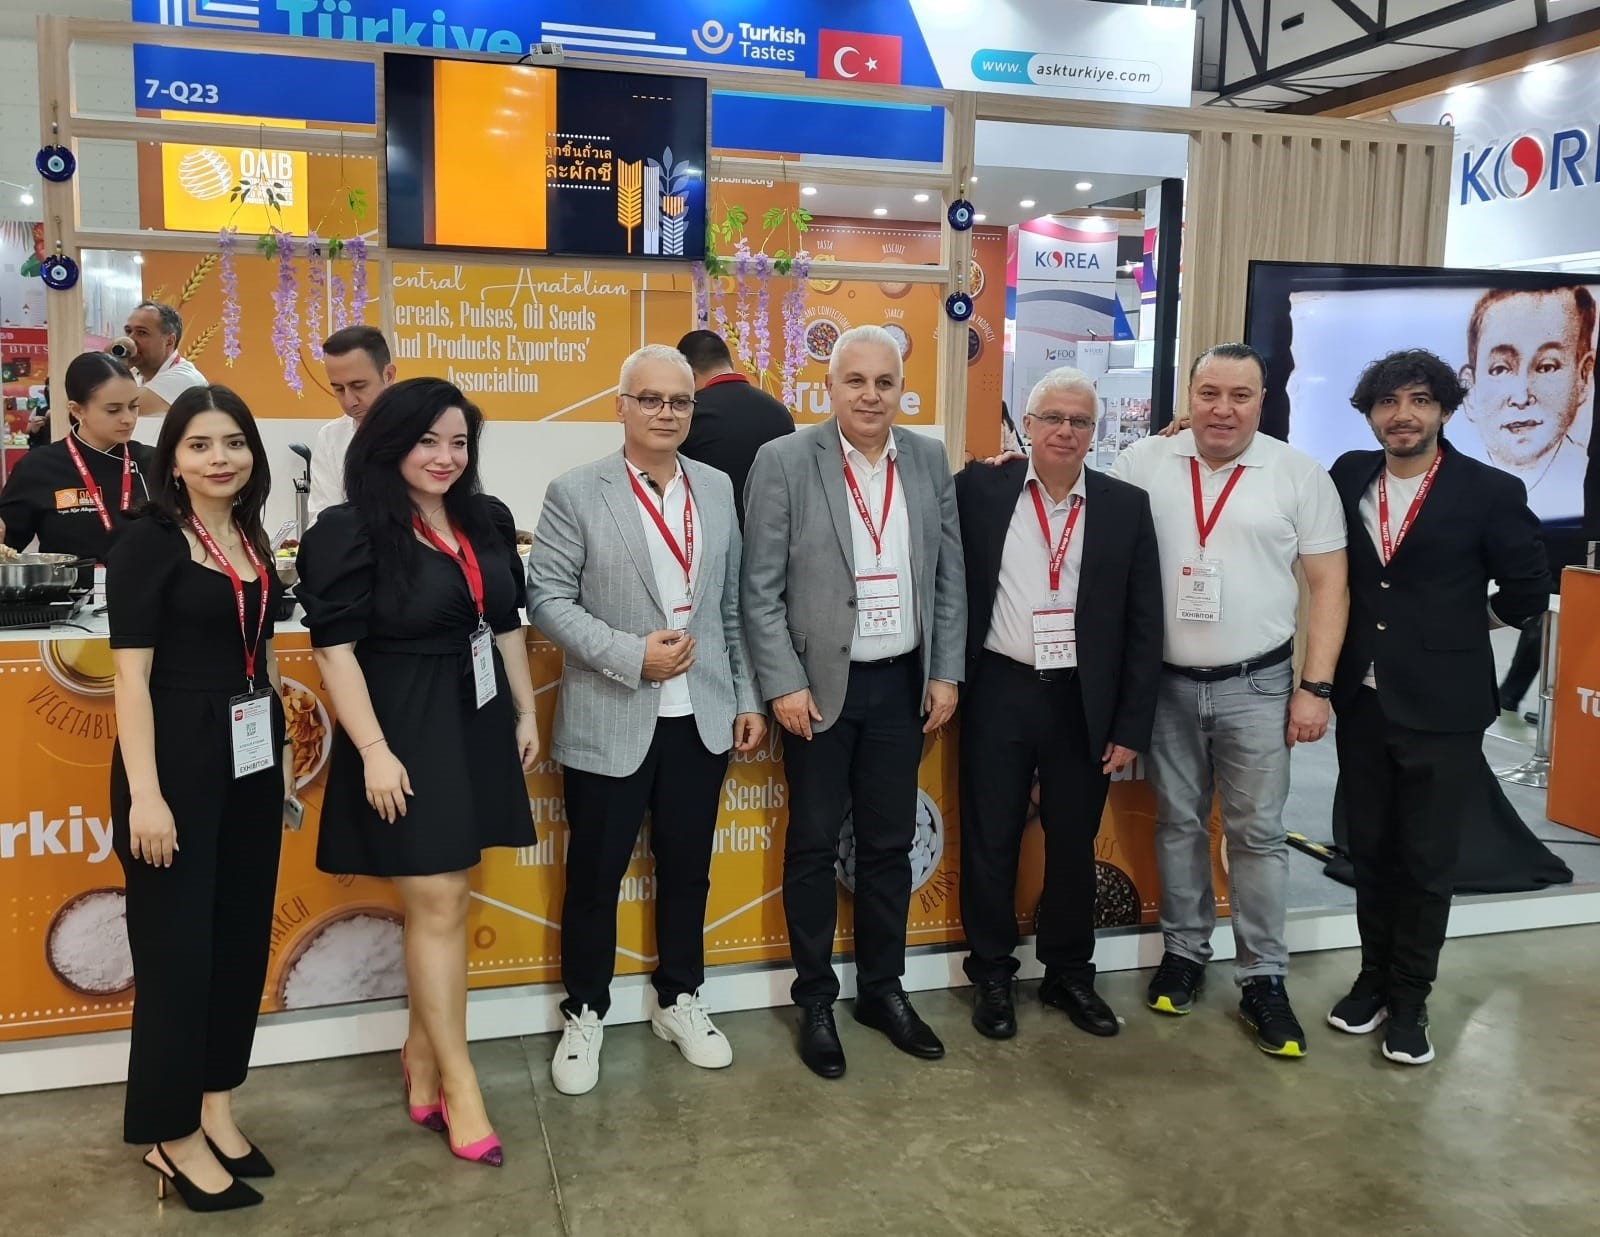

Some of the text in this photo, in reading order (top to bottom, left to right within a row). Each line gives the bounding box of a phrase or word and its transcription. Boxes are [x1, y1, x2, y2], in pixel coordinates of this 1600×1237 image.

[738, 22, 806, 45] Turkish
[738, 41, 796, 62] Tastes
[982, 60, 1151, 83] www. askturkiye.com
[144, 79, 219, 104] 7-Q23
[1035, 251, 1099, 269] KOREA
[392, 265, 629, 307] entral Anatolian
[392, 300, 597, 331] ereals, Pulses, Oil Seeds
[427, 332, 501, 361] Products
[447, 365, 538, 393] Association
[1181, 611, 1214, 620] EXHIBITOR
[27, 684, 118, 740] VEGETABL
[239, 759, 269, 774] EXHIBITOR
[725, 776, 785, 812] Seeds
[0, 806, 113, 864] rkiy
[919, 867, 959, 914] BEANS
